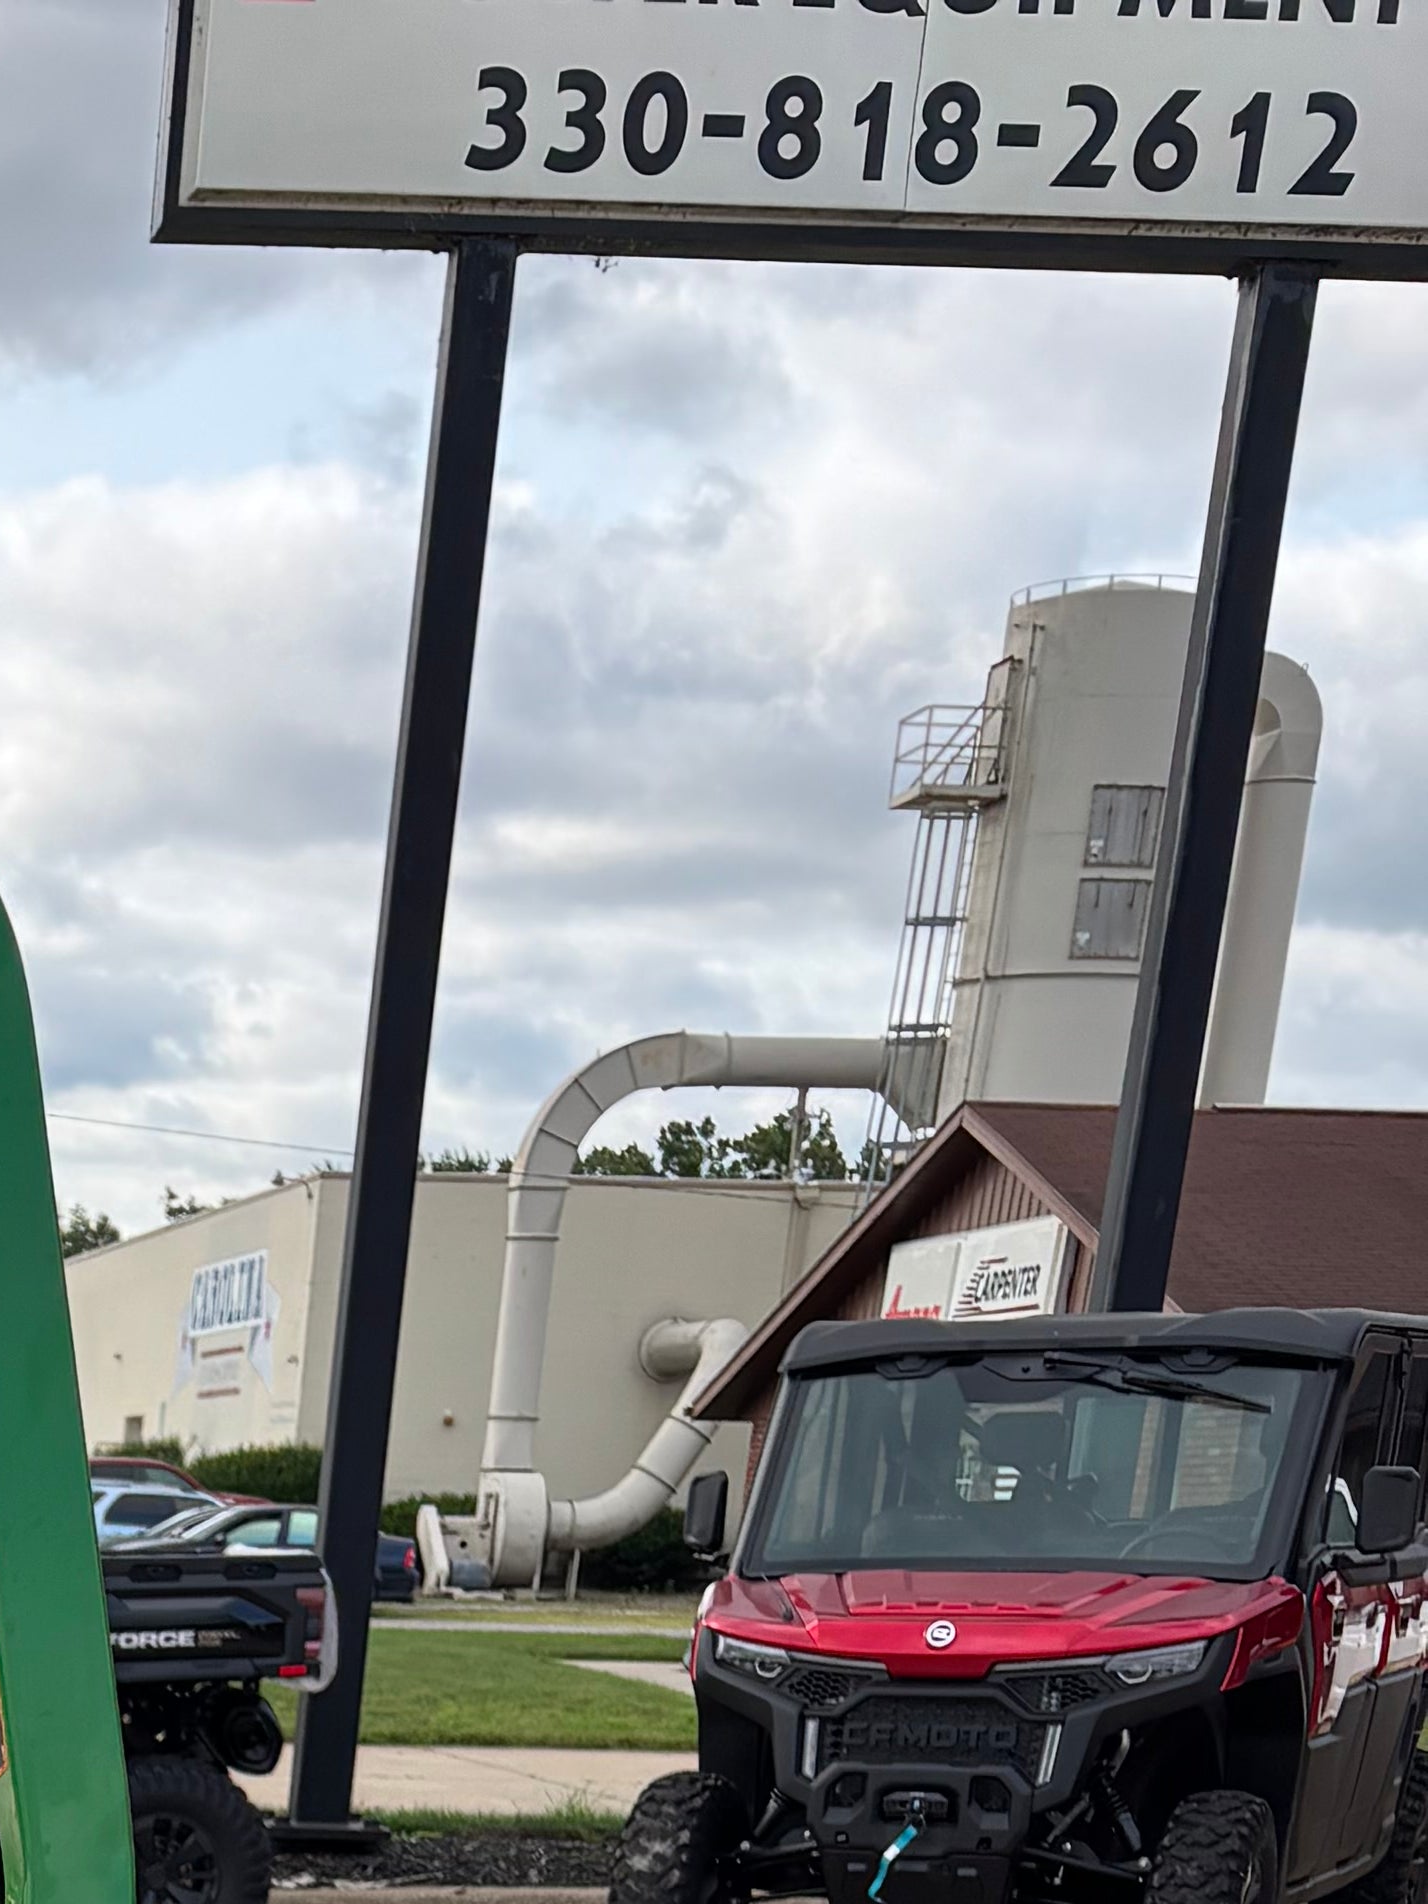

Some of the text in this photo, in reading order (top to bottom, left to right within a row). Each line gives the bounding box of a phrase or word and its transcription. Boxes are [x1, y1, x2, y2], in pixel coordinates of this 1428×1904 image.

[464, 65, 1358, 197] 330-818-2612
[975, 1264, 1042, 1304] CARPENTER
[845, 1720, 1018, 1748] CFMOTO
